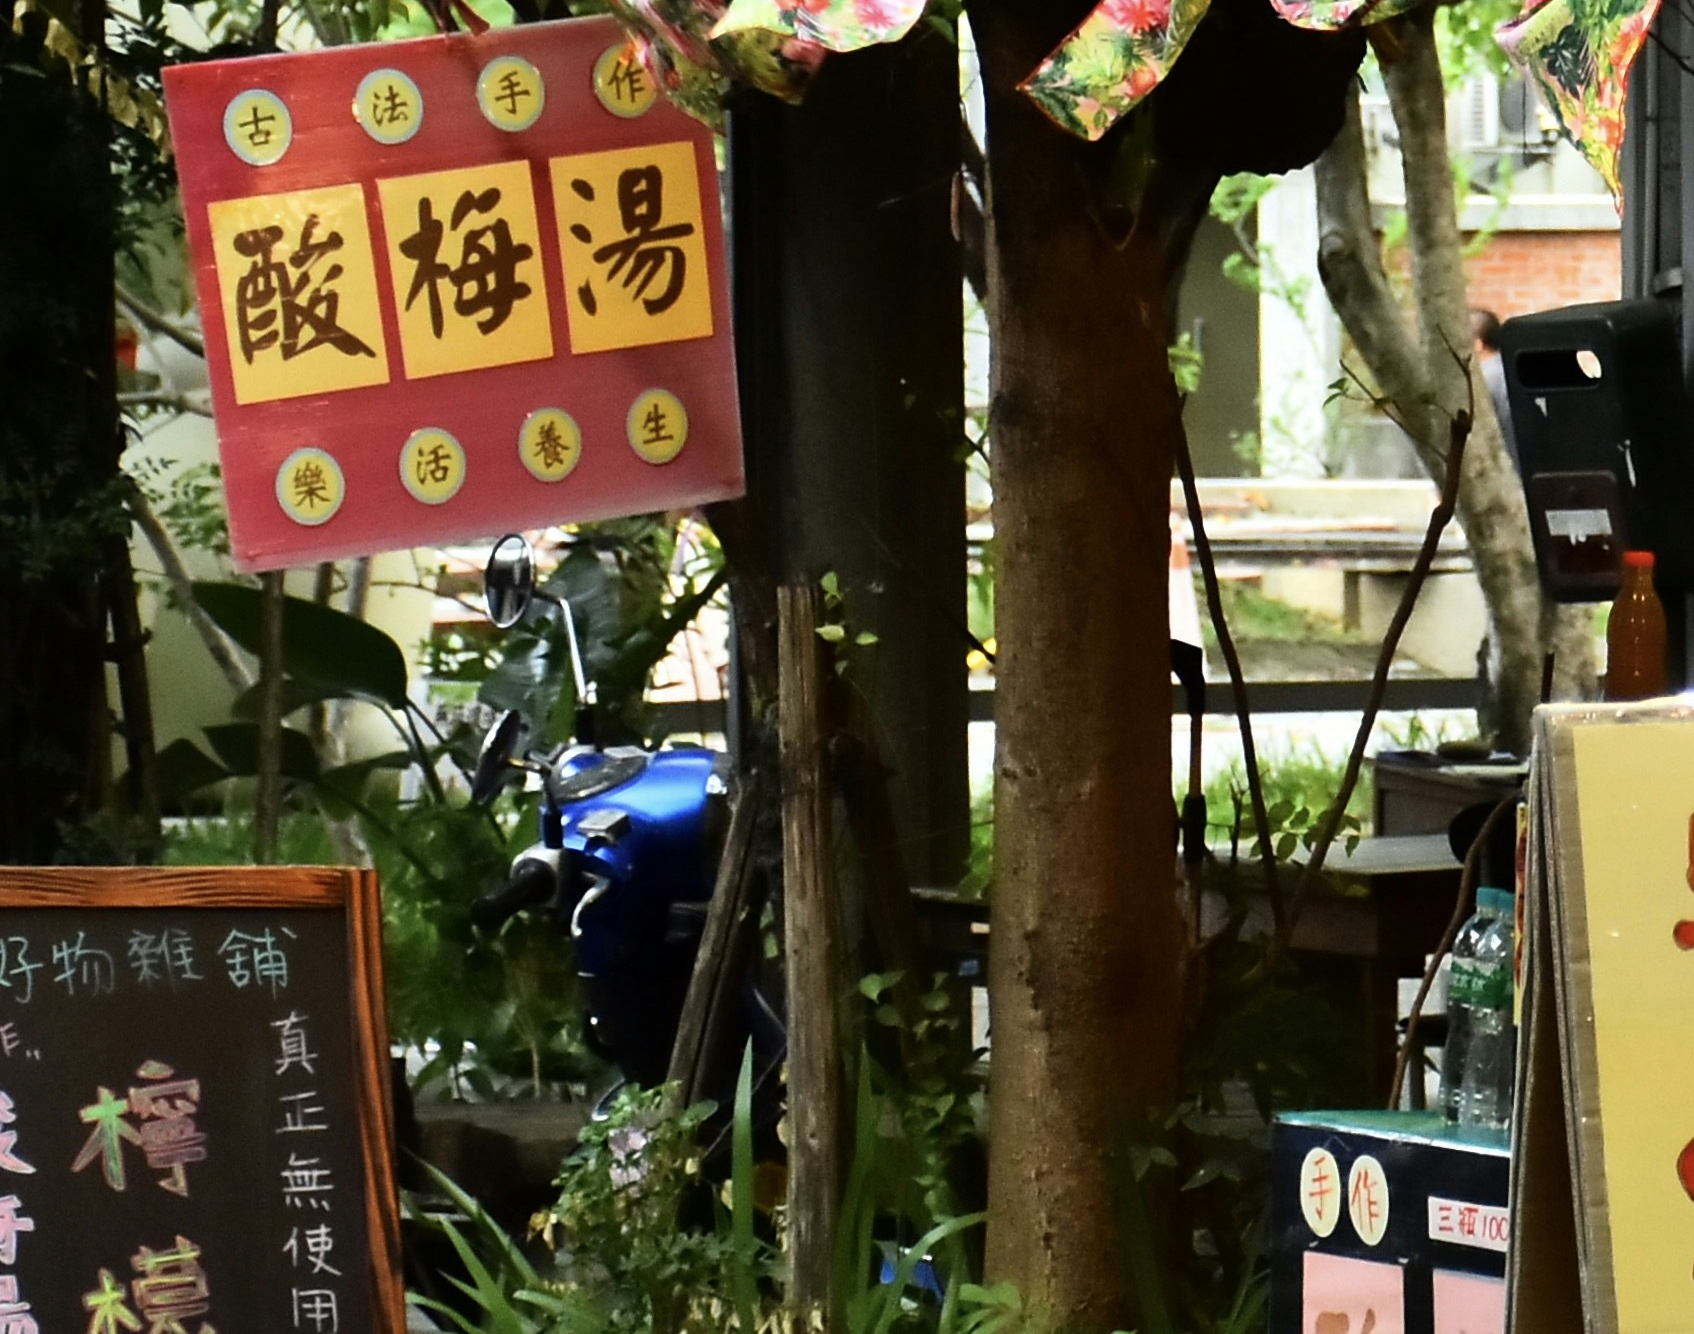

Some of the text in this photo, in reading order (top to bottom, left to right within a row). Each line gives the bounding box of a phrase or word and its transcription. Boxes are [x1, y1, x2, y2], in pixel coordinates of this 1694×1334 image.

[238, 57, 646, 147] 古法手作
[232, 165, 695, 366] 酸梅湯
[293, 402, 676, 509] 樂活養生
[1308, 1156, 1380, 1234] 手作
